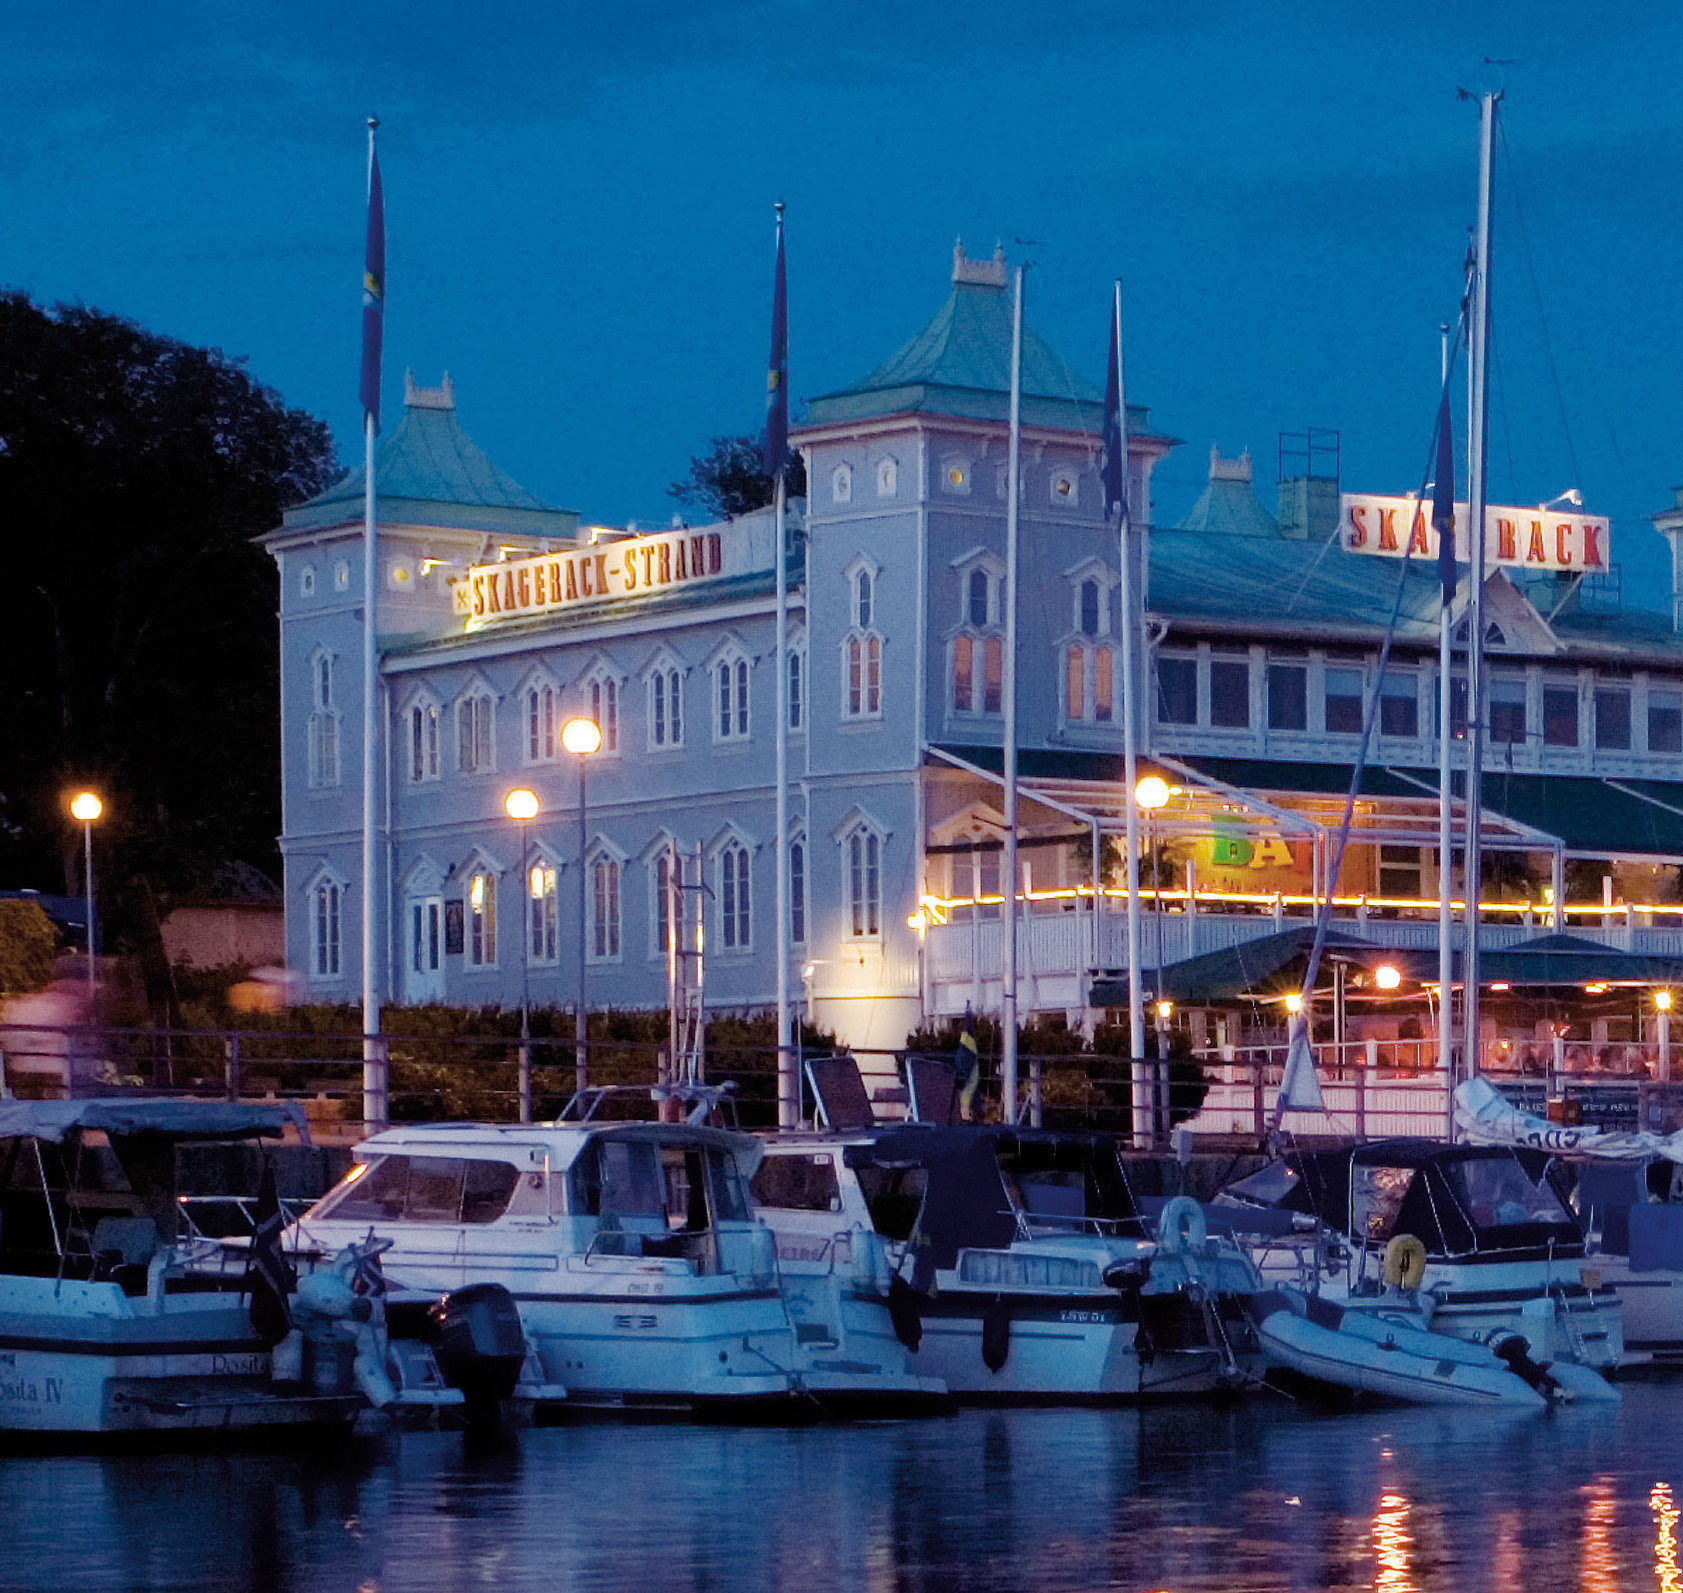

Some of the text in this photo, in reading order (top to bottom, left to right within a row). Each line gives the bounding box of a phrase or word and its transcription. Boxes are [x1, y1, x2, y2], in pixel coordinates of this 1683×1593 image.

[1351, 505, 1602, 566] SKARACK
[473, 533, 722, 617] SKAGERACK-STRAND
[45, 1377, 64, 1404] IV
